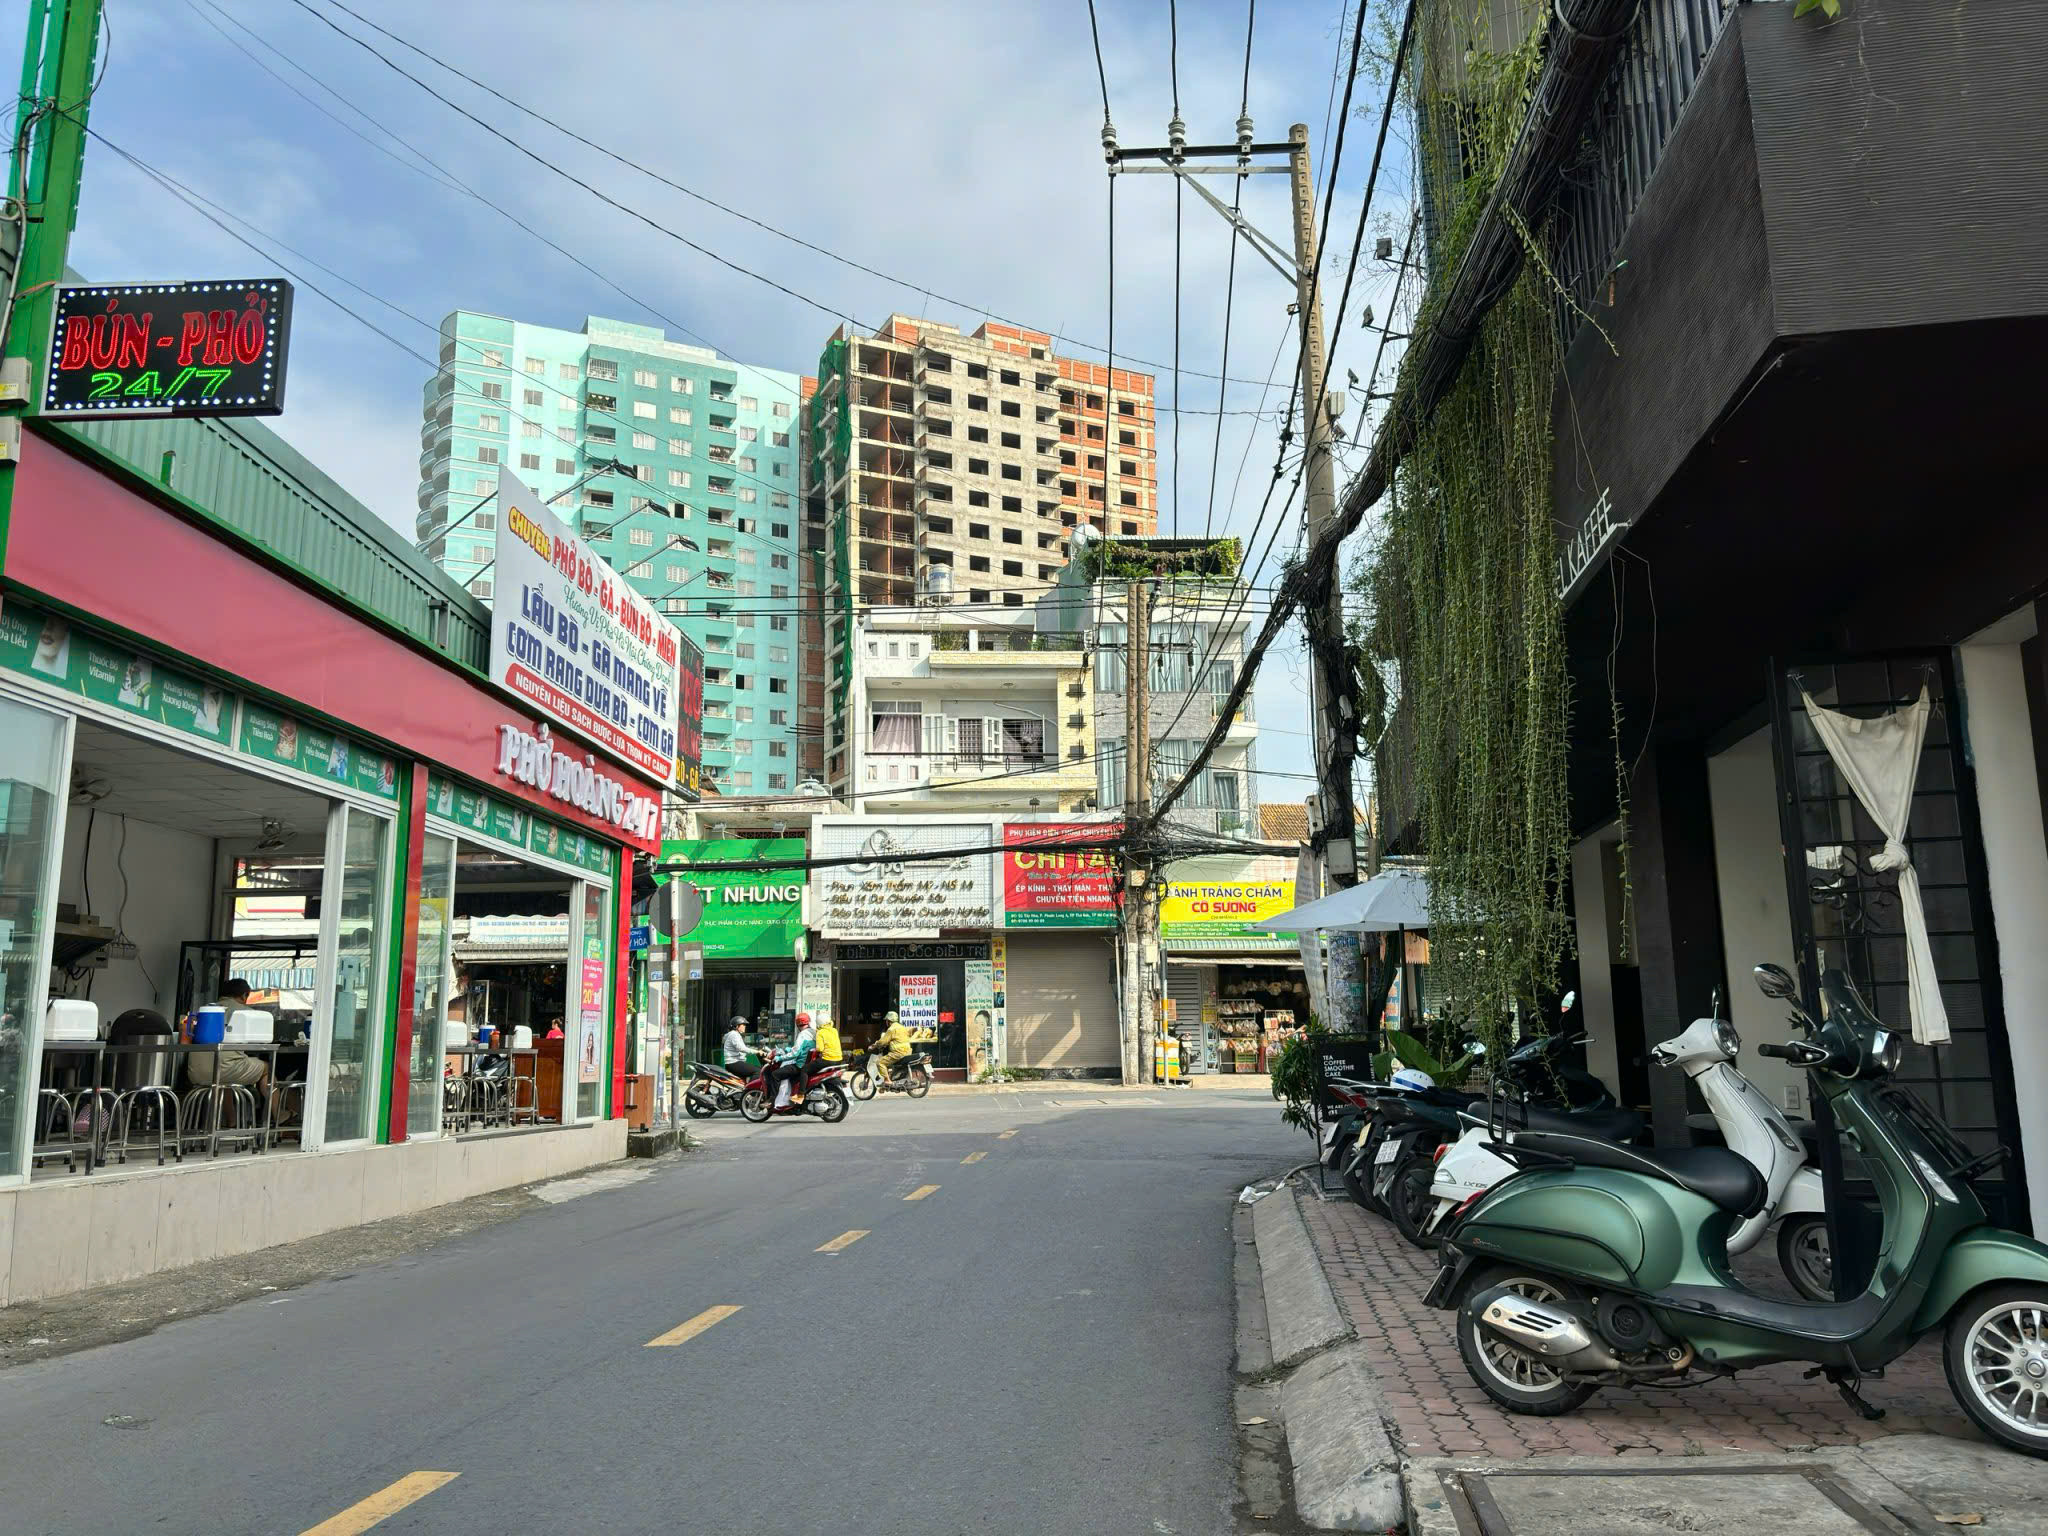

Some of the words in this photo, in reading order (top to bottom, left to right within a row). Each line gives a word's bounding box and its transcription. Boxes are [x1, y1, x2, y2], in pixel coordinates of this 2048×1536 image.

[61, 299, 153, 370] BÚN
[178, 292, 267, 365] PHỞ
[88, 367, 231, 400] 24/7
[508, 506, 551, 562] CHUYÊN:
[552, 536, 577, 582] PHỞ
[577, 557, 593, 596] BÒ
[600, 578, 614, 616] GÀ
[620, 597, 638, 637] BÚN
[639, 613, 651, 647] BÒ
[2, 615, 10, 629] Dị
[11, 616, 28, 635] Ứng
[564, 584, 589, 628] Hương
[589, 607, 599, 632] Vị
[599, 616, 614, 639] Phở
[614, 627, 624, 649] Hà
[625, 637, 637, 661] Nội
[10, 632, 28, 648] Liễu
[521, 582, 554, 636] LẨU
[557, 611, 578, 654] BÒ
[592, 640, 610, 679] GÀ
[613, 655, 650, 708] MANG
[652, 684, 668, 719] VỀ
[89, 651, 109, 668] Thuốc
[109, 657, 119, 671] Bổ
[89, 665, 116, 684] Vitamin
[163, 680, 183, 696] Kháng
[506, 621, 542, 674] CƠM
[544, 646, 583, 700] RANG
[584, 674, 610, 719] DƯA
[612, 694, 628, 730] BÒ
[637, 713, 659, 751] CƠM
[661, 728, 673, 760] GÀ
[161, 692, 181, 708] Xương
[515, 671, 551, 704] NGUYÊN
[552, 695, 570, 716] LIỆU
[572, 707, 592, 730] SẠCH
[593, 721, 611, 742] ĐƯỢC
[613, 734, 625, 752] LỰA
[626, 740, 643, 761] TRỌN
[643, 750, 652, 766] KỸ
[652, 757, 668, 776] CÀNG
[498, 722, 554, 791] PHỞ
[550, 753, 624, 825] HOÀNG
[676, 756, 685, 784] BÒ
[689, 765, 699, 792] GÀ
[1009, 829, 1023, 838] PHỤ
[724, 885, 800, 903] NHUNG
[1015, 884, 1026, 893] ÉP
[1028, 884, 1045, 892] KÍNH
[1074, 884, 1090, 892] MÀN
[1201, 886, 1242, 897] TRÁNG
[1246, 884, 1282, 897] CHẤM
[1036, 893, 1066, 903] CHUYỂN
[1067, 893, 1085, 902] TIỀN
[1192, 901, 1208, 913] CÔ
[1213, 901, 1256, 913] SƯƠNG
[901, 977, 936, 985] MASSAGE
[904, 988, 915, 996] TRỊ
[918, 987, 933, 995] LIỆU
[913, 1008, 936, 1017] THÔNG
